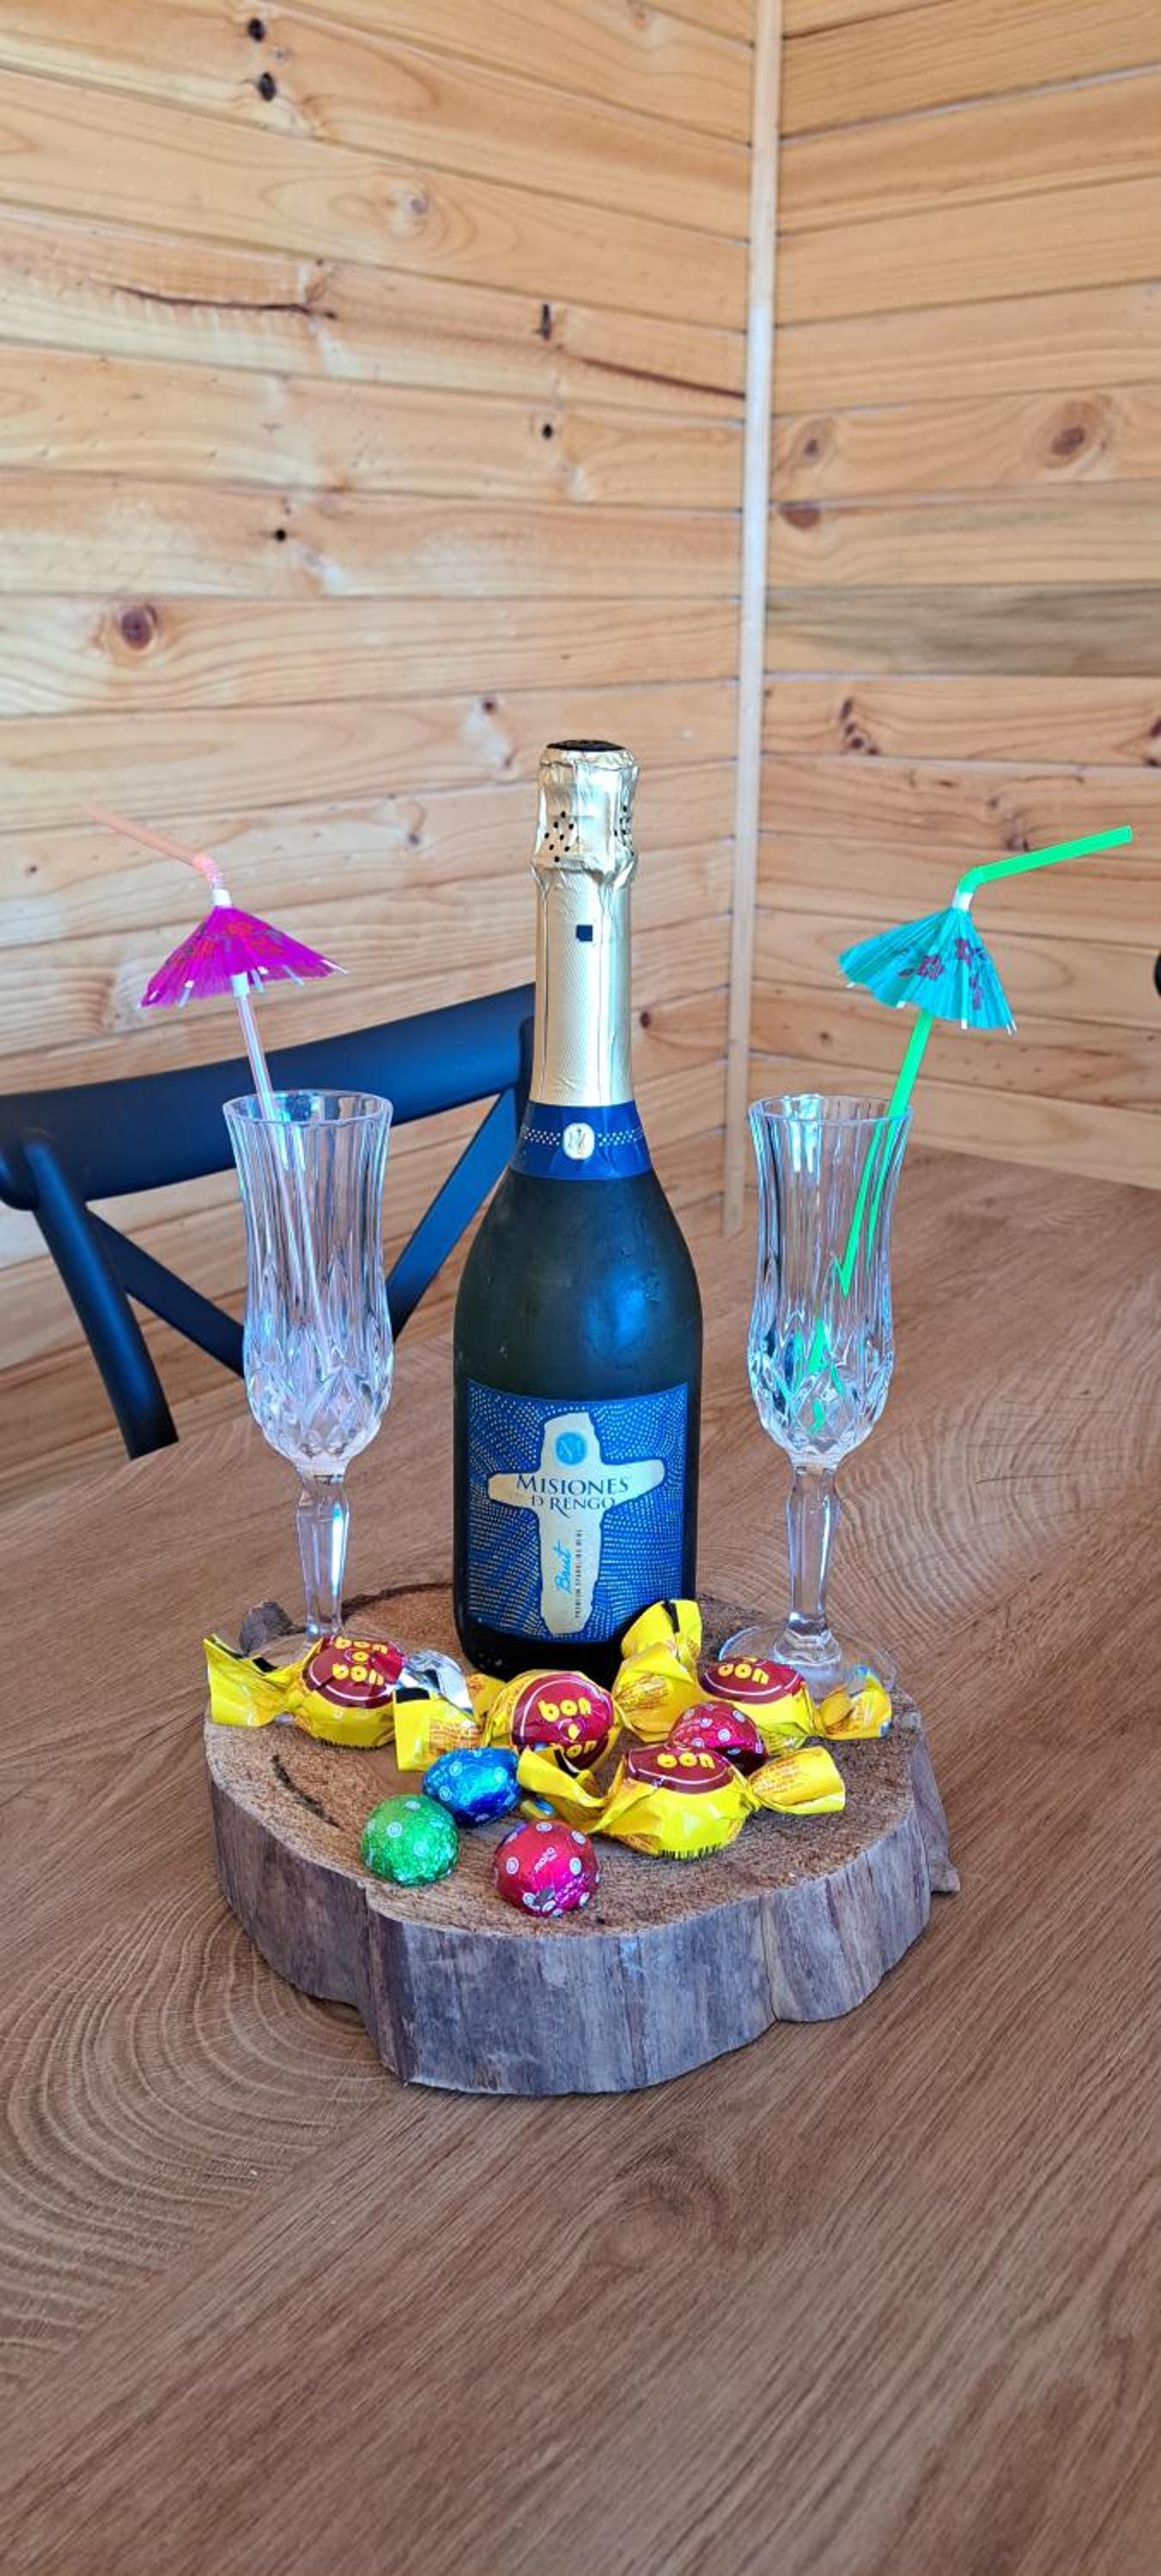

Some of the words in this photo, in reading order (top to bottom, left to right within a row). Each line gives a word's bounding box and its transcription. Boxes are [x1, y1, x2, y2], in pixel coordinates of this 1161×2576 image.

[516, 1474, 629, 1495] MISIONES
[550, 1497, 616, 1518] RENGO
[553, 1539, 573, 1594] Brut
[334, 1636, 388, 1656] bon
[332, 1662, 385, 1686] bon
[538, 1697, 593, 1722] bon
[657, 1753, 714, 1769] bon
